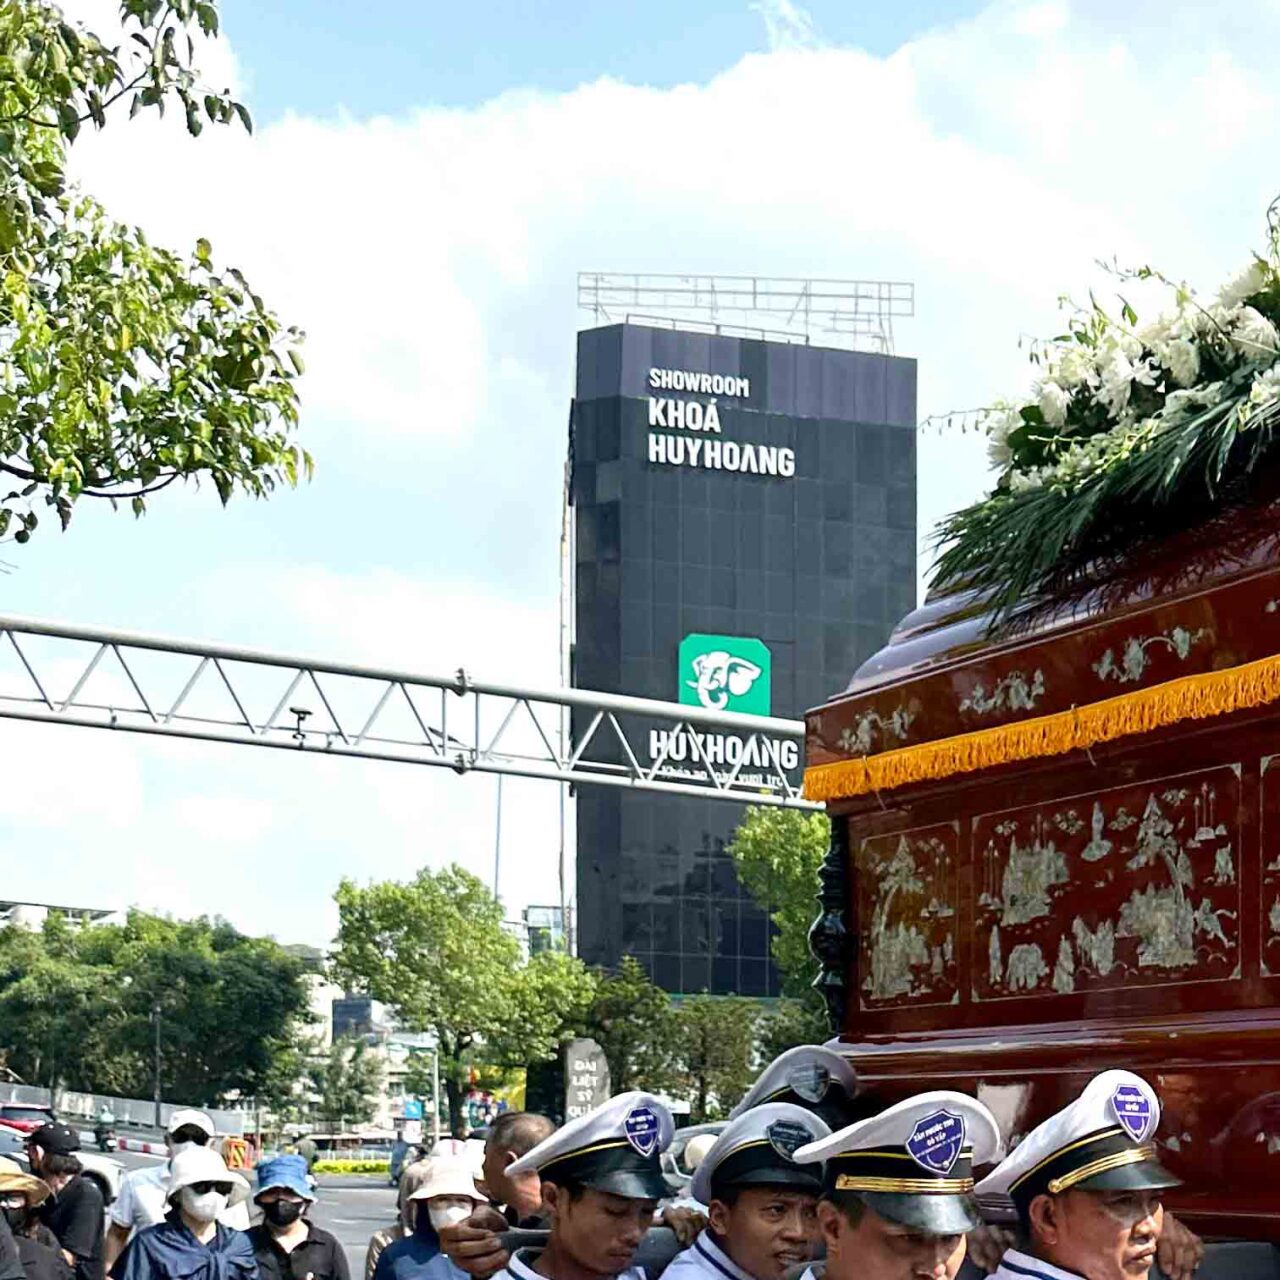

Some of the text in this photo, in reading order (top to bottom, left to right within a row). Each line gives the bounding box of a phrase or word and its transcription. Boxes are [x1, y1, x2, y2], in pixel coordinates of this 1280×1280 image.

[649, 367, 750, 398] SHOWROOM
[648, 397, 722, 433] KHOÁ
[648, 434, 796, 478] HUYHOANG
